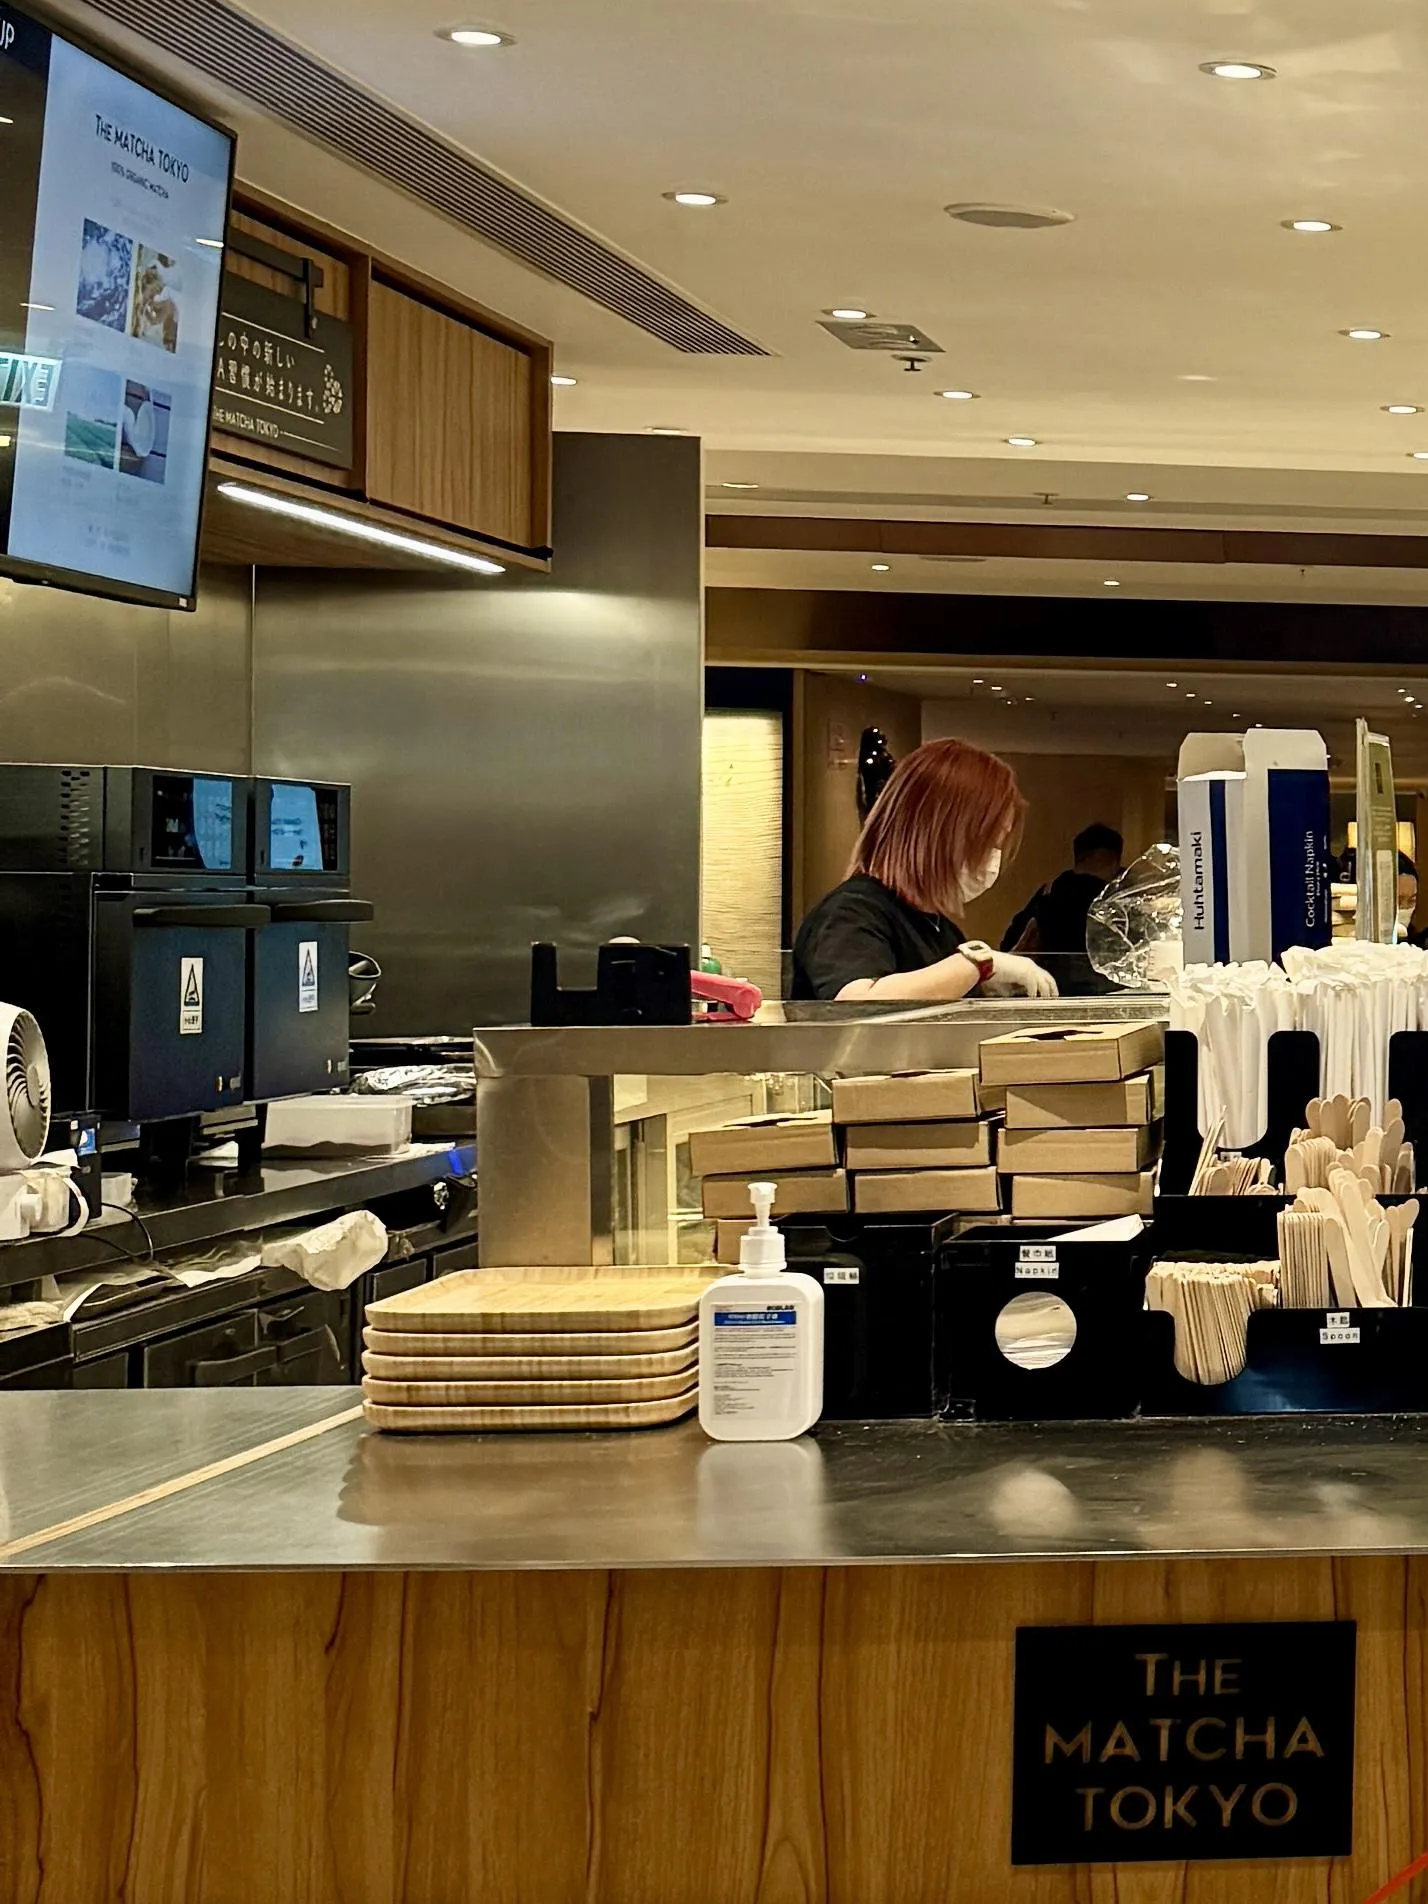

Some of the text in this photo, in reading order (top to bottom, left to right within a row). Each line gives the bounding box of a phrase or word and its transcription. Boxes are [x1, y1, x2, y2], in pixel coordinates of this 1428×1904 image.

[96, 113, 190, 183] THE MATCHA TOKYO
[225, 411, 255, 432] MATCHA
[1190, 831, 1205, 930] Huhtamaki
[1303, 830, 1316, 928] Cocktail Napkin
[1134, 1652, 1244, 1697] THE
[1043, 1715, 1327, 1765] MATCHA
[1075, 1781, 1299, 1832] TOKYO
